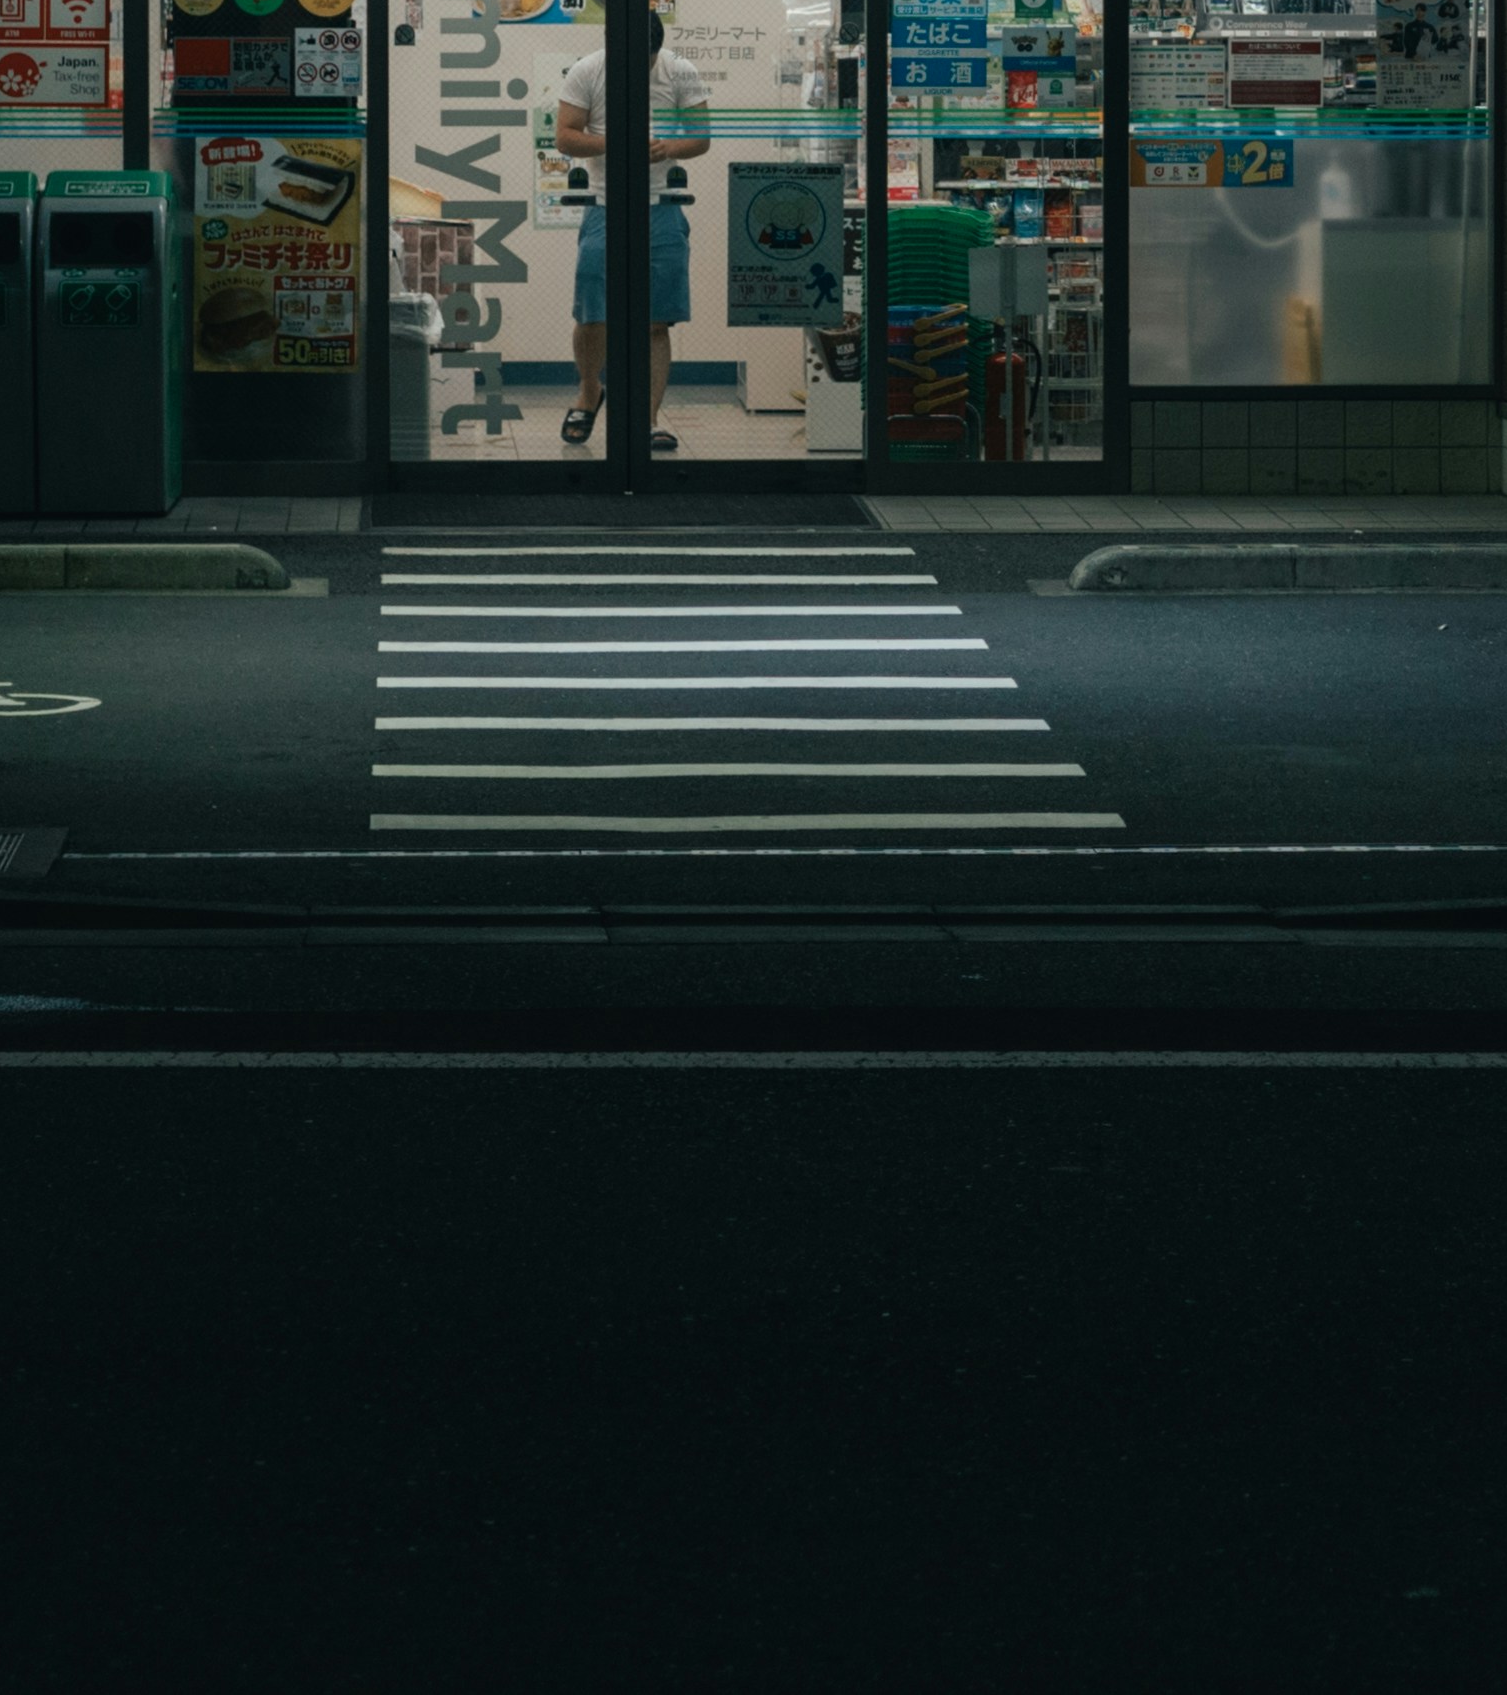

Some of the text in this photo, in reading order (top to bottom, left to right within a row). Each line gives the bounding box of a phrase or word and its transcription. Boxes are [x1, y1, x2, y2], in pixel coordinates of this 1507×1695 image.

[1225, 20, 1308, 29] Convenience Wear
[4, 29, 21, 38] ATM
[671, 26, 767, 42] ファミリーマート
[906, 22, 972, 45] たばこ
[671, 46, 756, 61] 羽田六丁目店
[918, 49, 960, 57] CIGARETTE
[58, 55, 100, 70] Japan.
[53, 71, 100, 83] Tax-free
[69, 84, 100, 97] Shop
[177, 77, 229, 91] SECOM
[923, 87, 953, 96] LIQUOR
[208, 144, 257, 161] 新登場!
[1243, 140, 1268, 185] 2
[775, 230, 797, 241] SS
[202, 242, 352, 271] ファミチキ祭り
[68, 311, 131, 324] ビン カン
